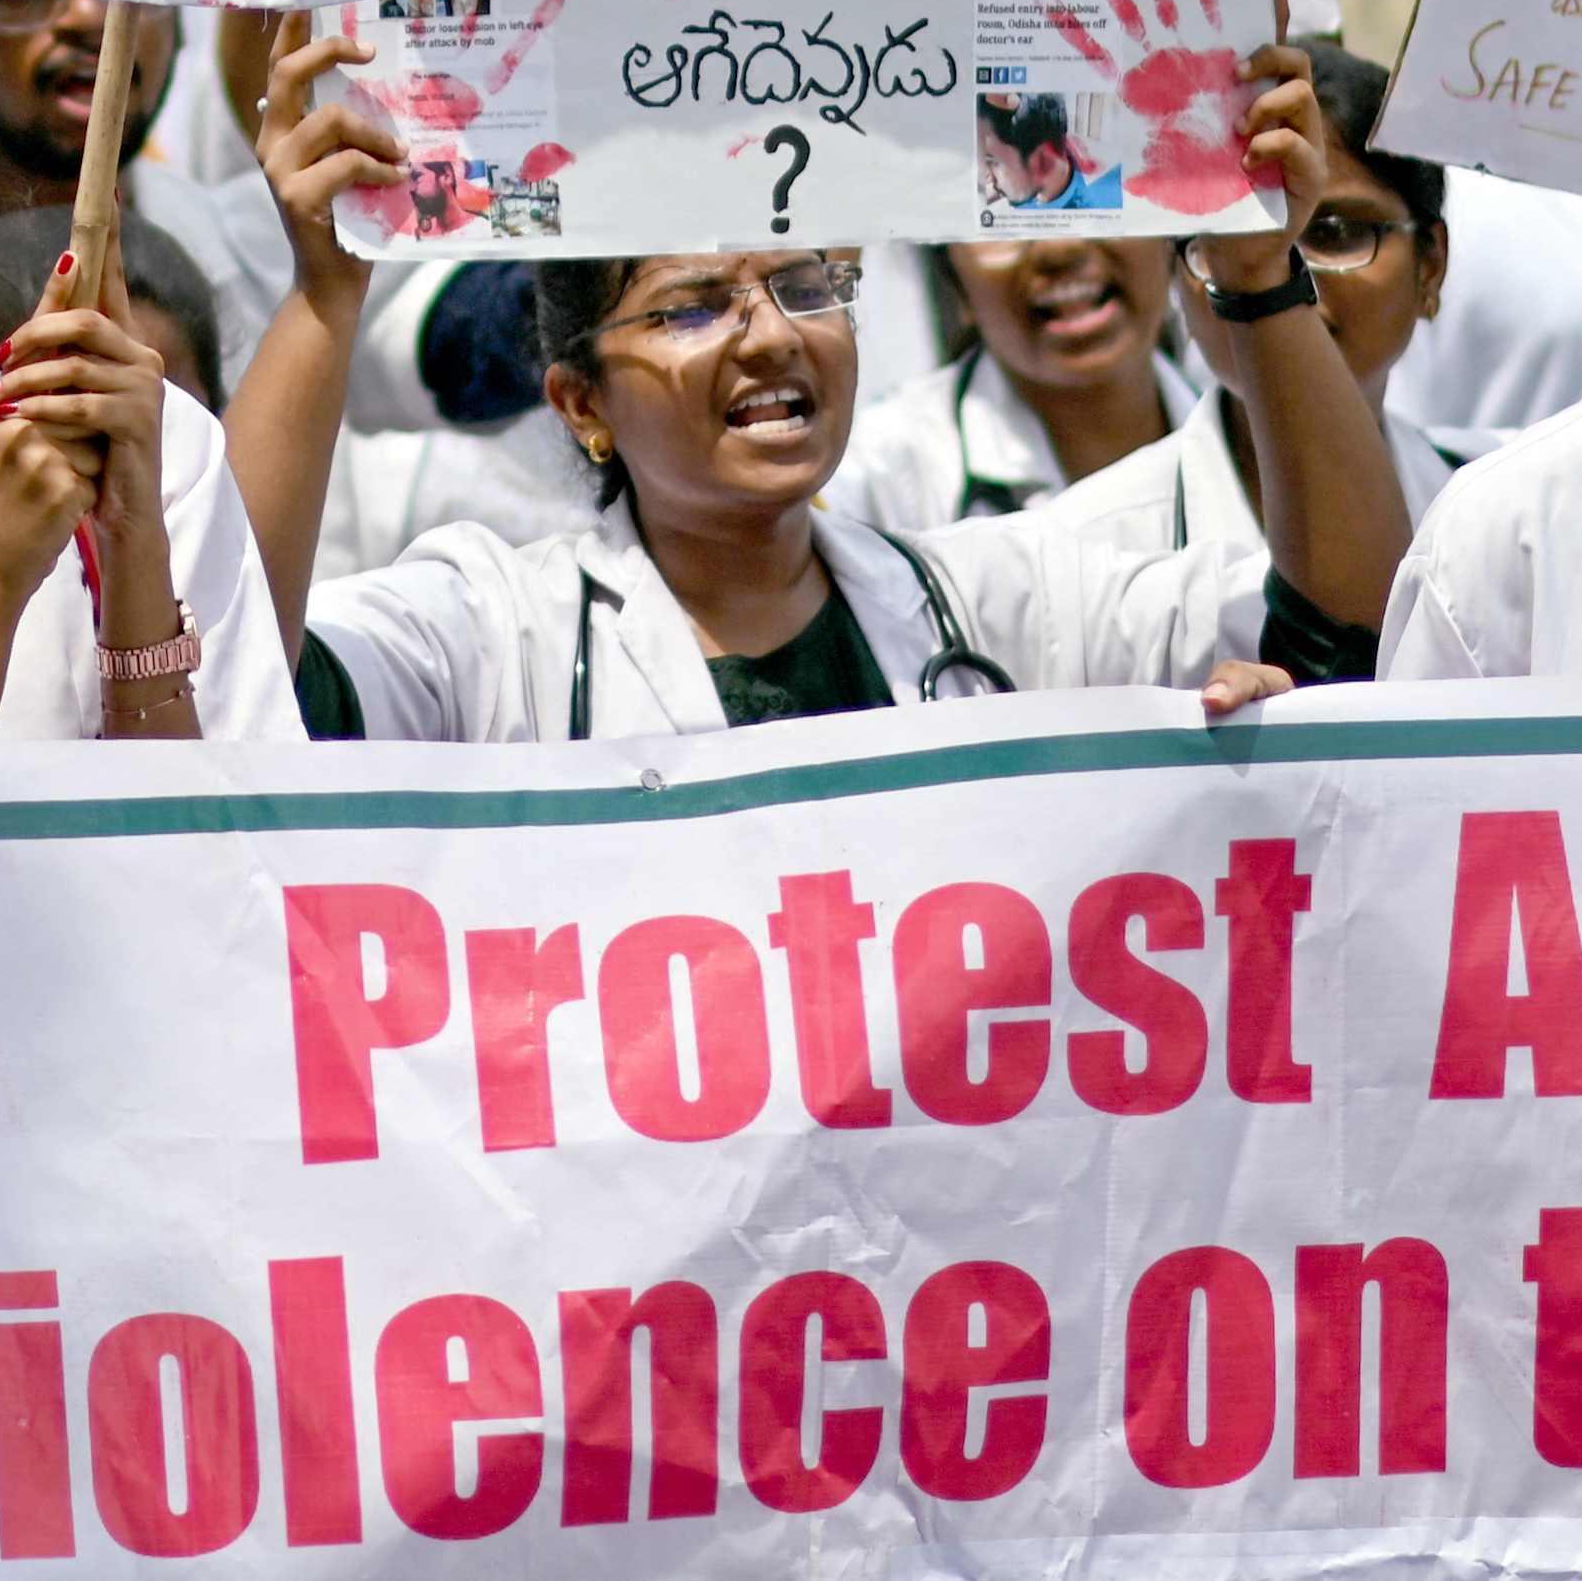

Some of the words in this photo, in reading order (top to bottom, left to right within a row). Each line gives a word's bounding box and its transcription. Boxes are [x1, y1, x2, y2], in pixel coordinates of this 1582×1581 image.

[977, 3, 1015, 14] Refused
[1017, 4, 1044, 16] entry
[1046, 3, 1067, 14] into
[1068, 3, 1100, 14] labour
[405, 24, 436, 35] Doctor
[439, 23, 464, 33] loses
[466, 22, 495, 32] vision
[498, 22, 507, 31] in
[509, 21, 525, 31] left
[526, 21, 544, 32] eye
[977, 20, 1005, 30] room,
[1008, 18, 1041, 29] Odisha
[1044, 20, 1066, 29] man
[1092, 18, 1108, 29] off
[405, 39, 426, 49] after
[429, 37, 457, 48] attack
[460, 37, 471, 49] by
[474, 36, 496, 47] mob
[976, 33, 1015, 44] doctor's
[1017, 35, 1034, 44] ear
[1440, 19, 1581, 110] SAFE
[763, 124, 810, 234] ?
[283, 837, 1312, 1165] Protest
[1123, 1235, 1451, 1490] on
